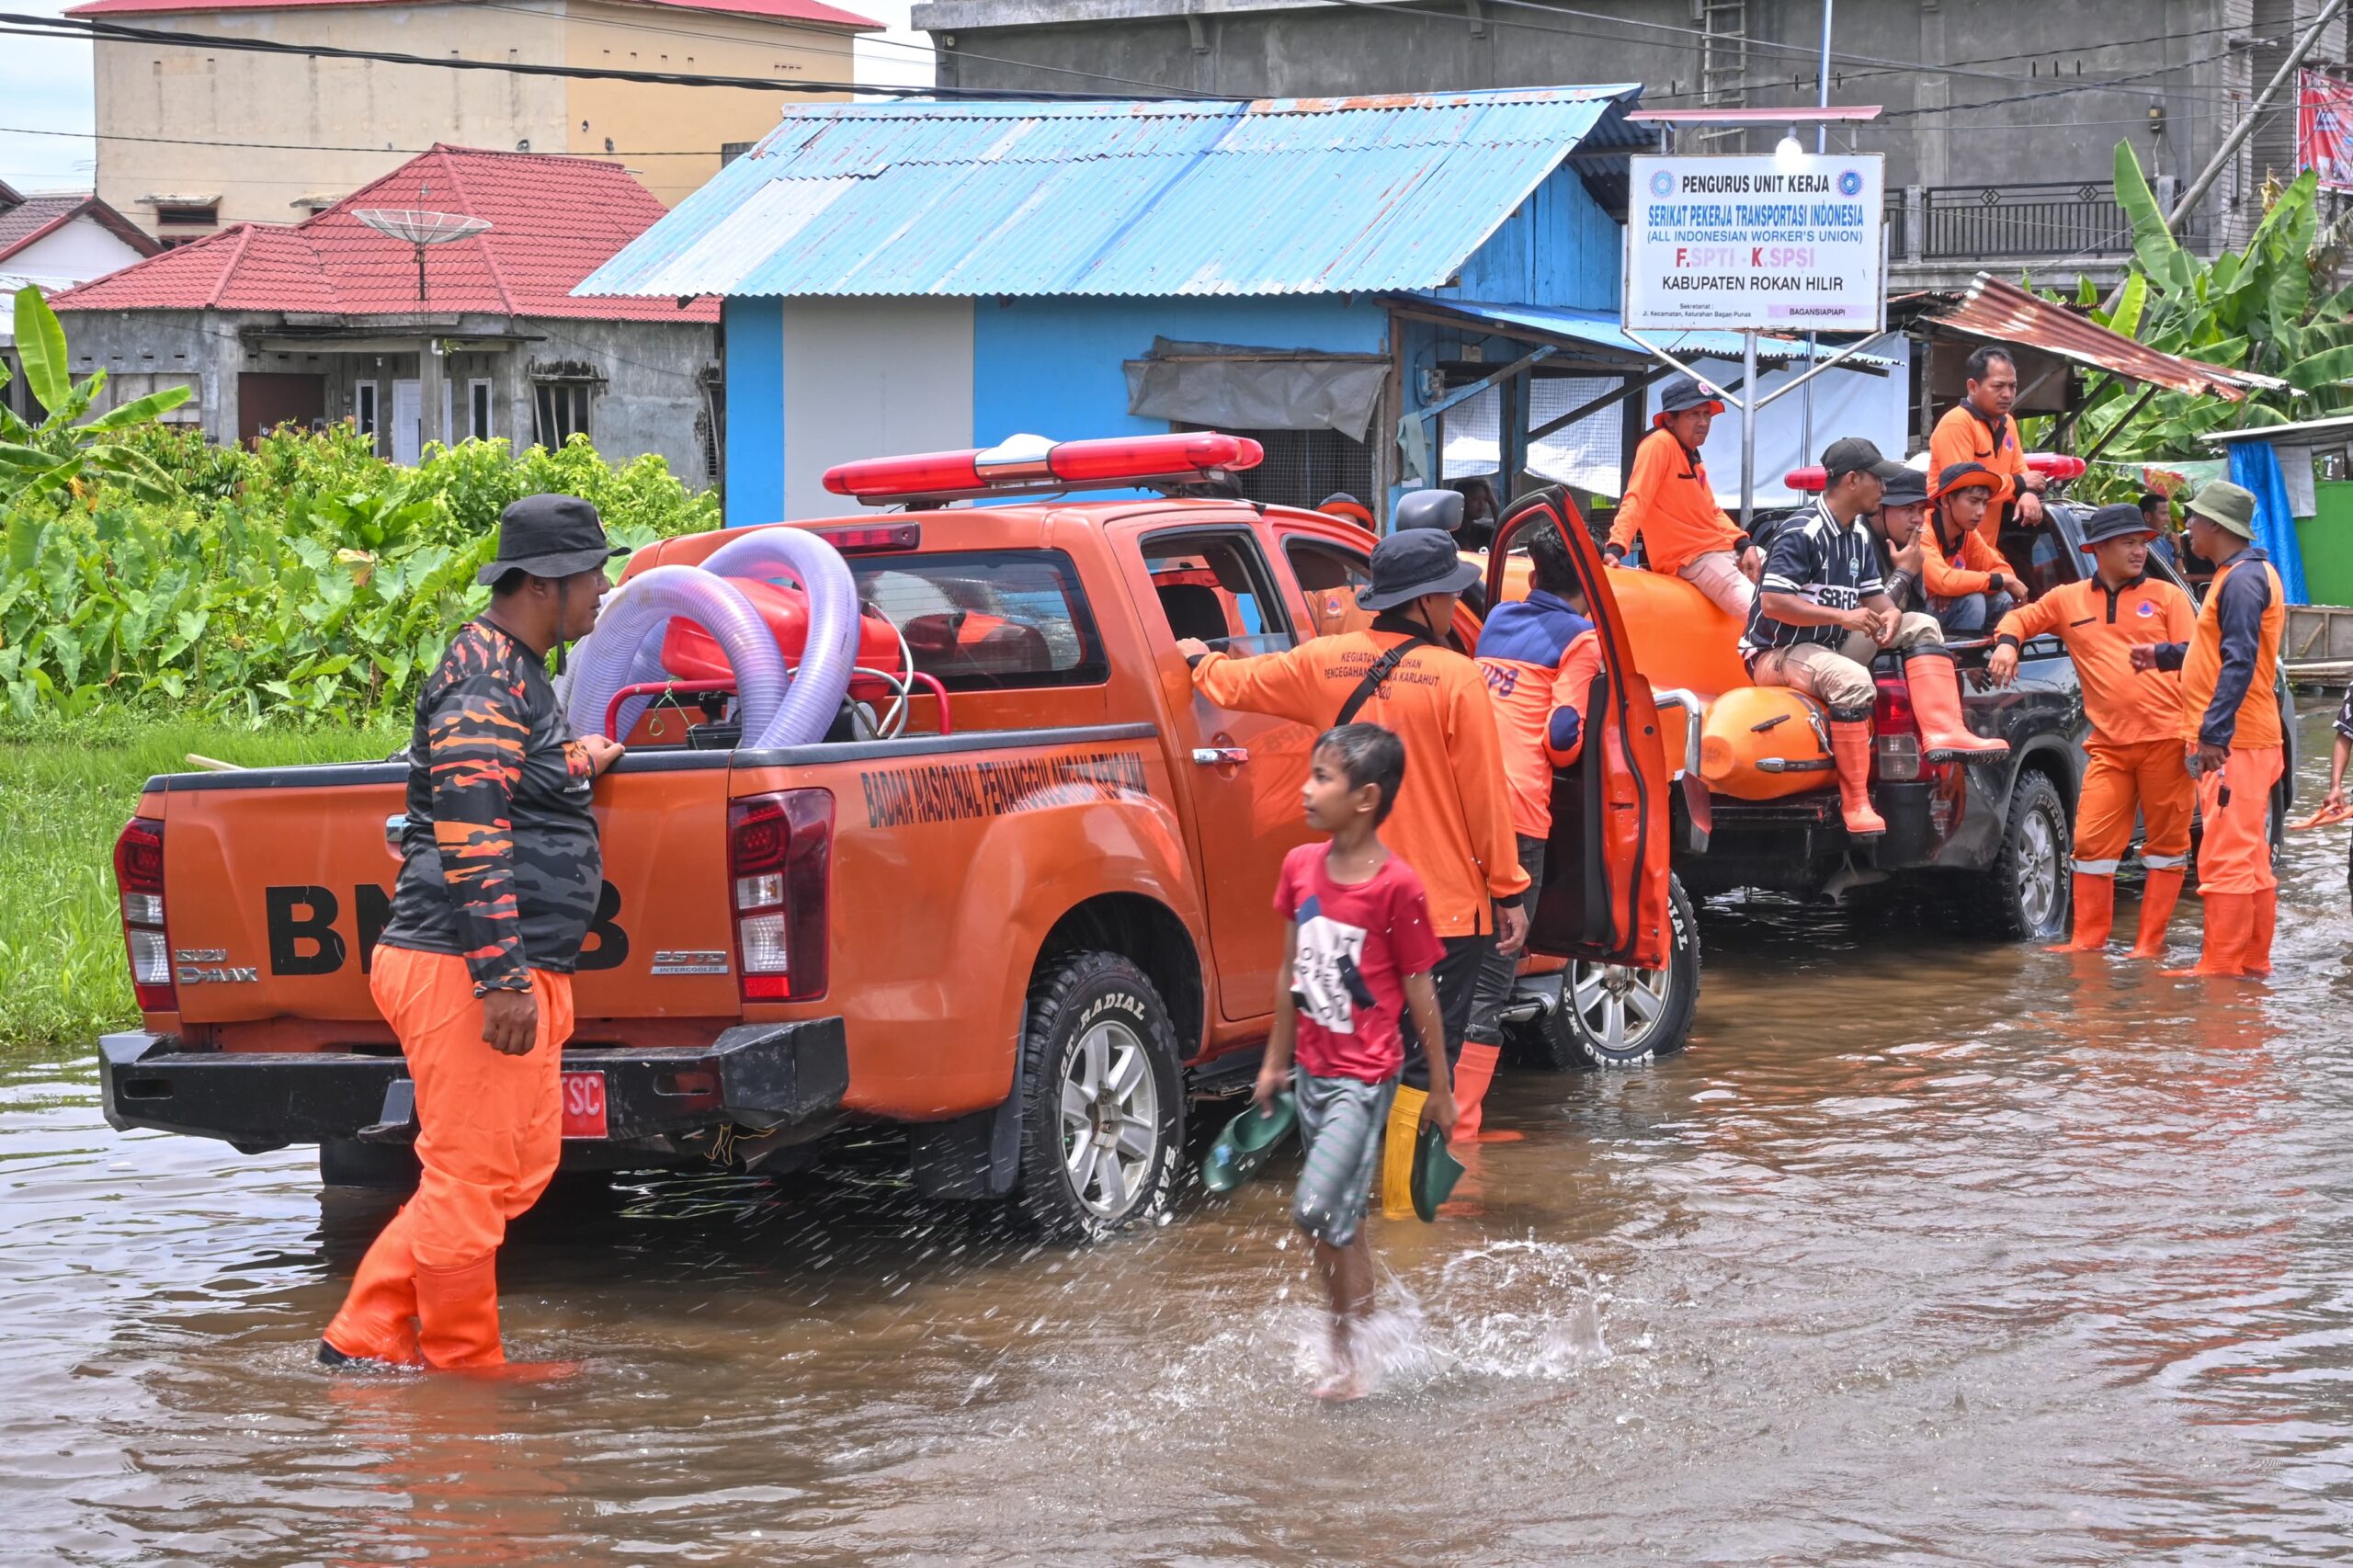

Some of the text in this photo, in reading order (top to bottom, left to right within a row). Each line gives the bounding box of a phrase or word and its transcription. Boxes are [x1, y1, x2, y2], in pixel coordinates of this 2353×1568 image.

[1682, 175, 1829, 193] PENGURUS UNIT KERJA
[1648, 204, 1864, 227] SERIKAT PEKERJA TRANSPORTASI INDONESIA
[1647, 231, 1863, 244] (ALL INDONESIAN WORKER'S UNION)
[1676, 247, 1736, 267] F.SPTI
[1751, 246, 1815, 267] K.SPSI
[1662, 276, 1844, 290] KABUPATEN ROKAN HILIR
[1789, 308, 1846, 316] BAGANSIAPIAPI
[1399, 672, 1440, 687] KARLAHUT
[860, 768, 915, 829] BADAN
[909, 764, 983, 824] NASIONAL
[176, 949, 227, 962] ISUZU
[176, 967, 258, 984] D-MAX
[1080, 993, 1146, 1031] RADIAL
[562, 1076, 600, 1116] SC
